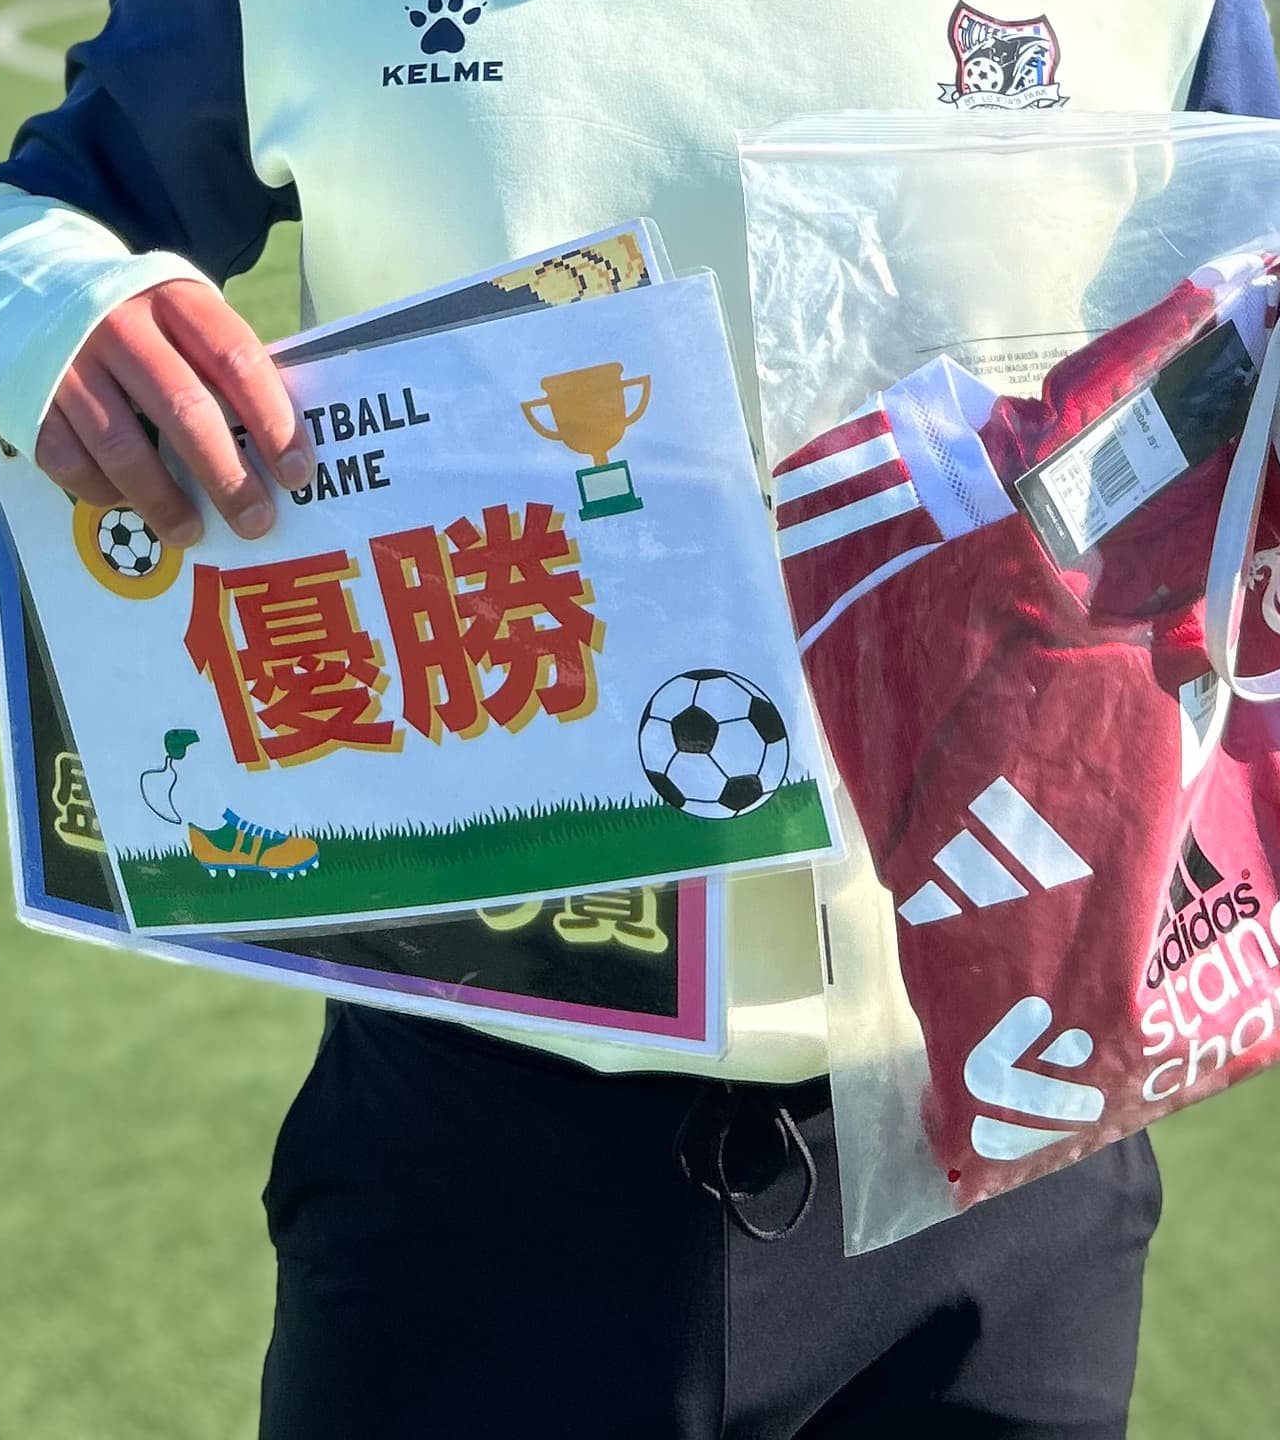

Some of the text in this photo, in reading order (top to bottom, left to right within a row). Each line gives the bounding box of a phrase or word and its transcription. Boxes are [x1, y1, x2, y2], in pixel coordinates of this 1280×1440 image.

[381, 60, 504, 88] KELME
[231, 387, 431, 448] TBALL
[183, 501, 607, 772] 優勝
[1146, 881, 1261, 990] adidas
